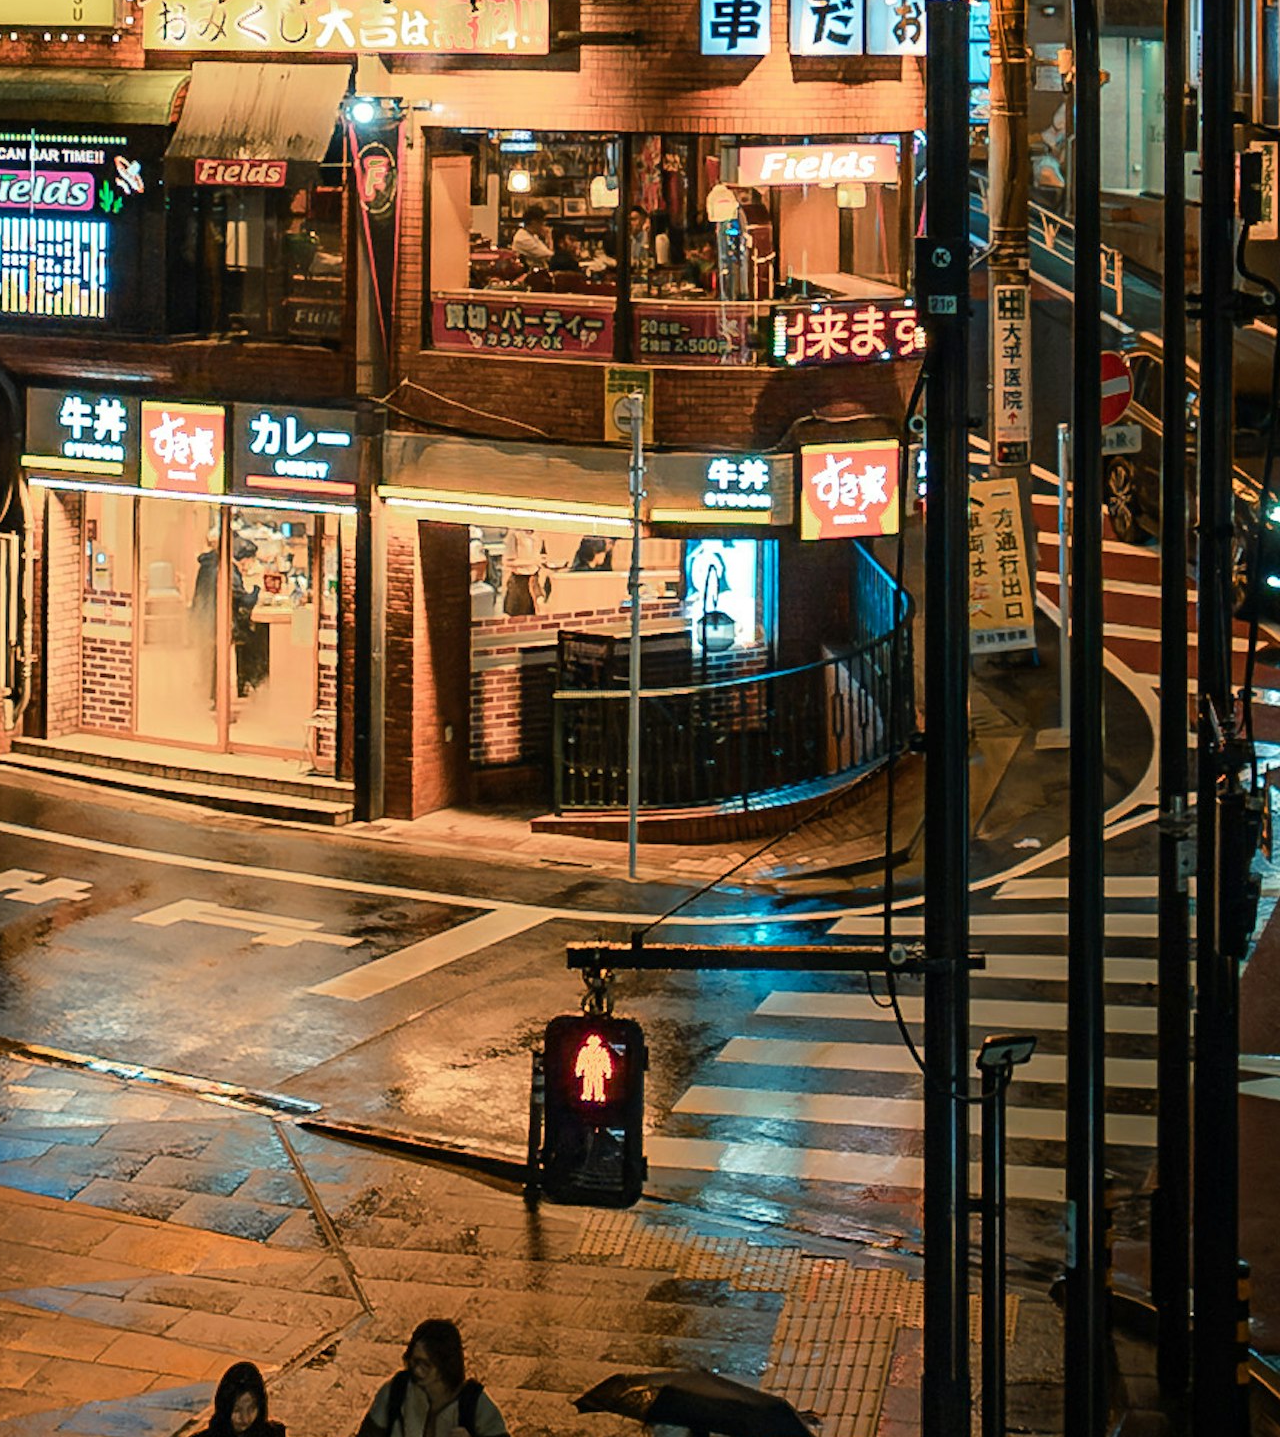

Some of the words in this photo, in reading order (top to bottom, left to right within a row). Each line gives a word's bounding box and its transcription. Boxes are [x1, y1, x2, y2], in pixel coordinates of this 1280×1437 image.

[29, 147, 60, 164] BAR
[199, 160, 282, 184] Fields
[759, 151, 877, 181] Fields
[1001, 322, 1023, 411] 大平医院
[59, 395, 128, 442] 牛丼
[149, 411, 216, 470] すき家
[248, 412, 352, 457] カレー
[706, 456, 770, 492] 牛丼
[811, 453, 889, 512] すき家
[990, 491, 1025, 619] 一方通行出口
